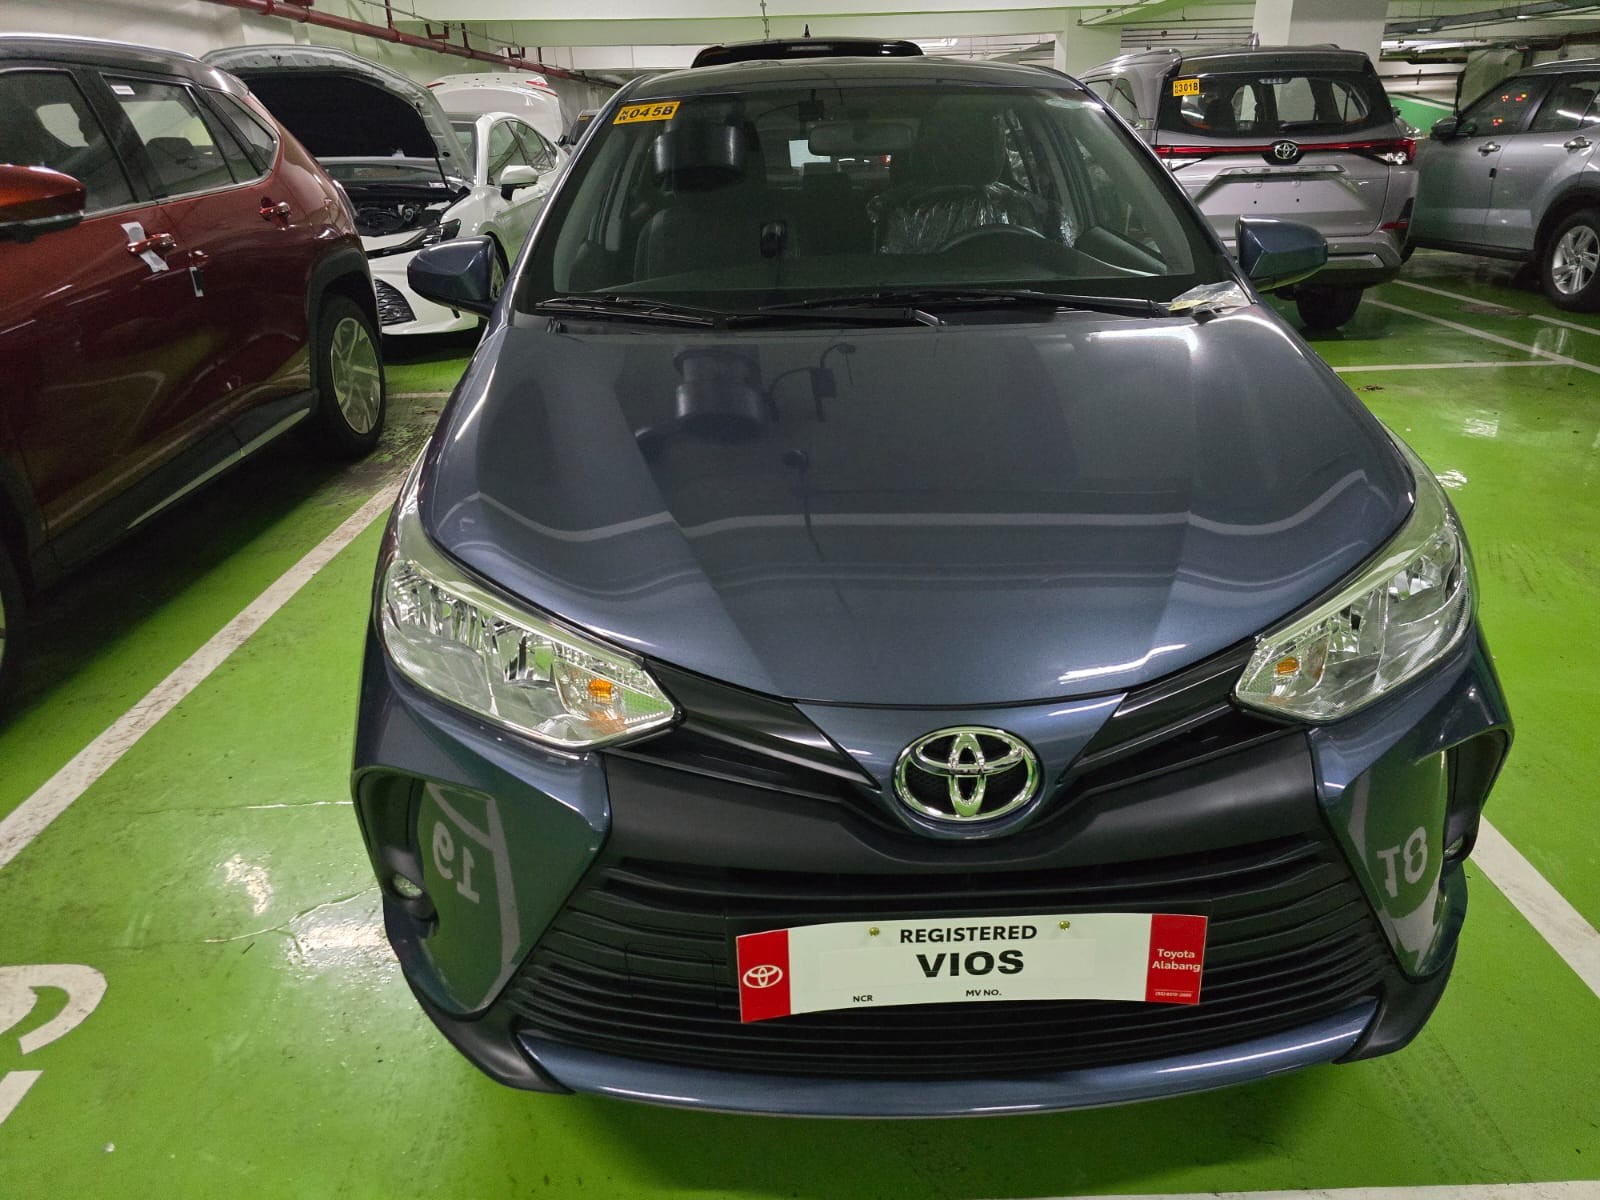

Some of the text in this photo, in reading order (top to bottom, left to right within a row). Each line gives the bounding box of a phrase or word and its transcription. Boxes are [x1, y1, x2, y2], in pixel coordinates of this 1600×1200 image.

[900, 925, 1037, 943] REGISTERED
[1157, 949, 1195, 959] Toyota
[916, 949, 1024, 978] VIOS
[1152, 961, 1201, 973] Alabang
[966, 989, 1002, 997] MV NO.
[852, 995, 873, 1003] NCR
